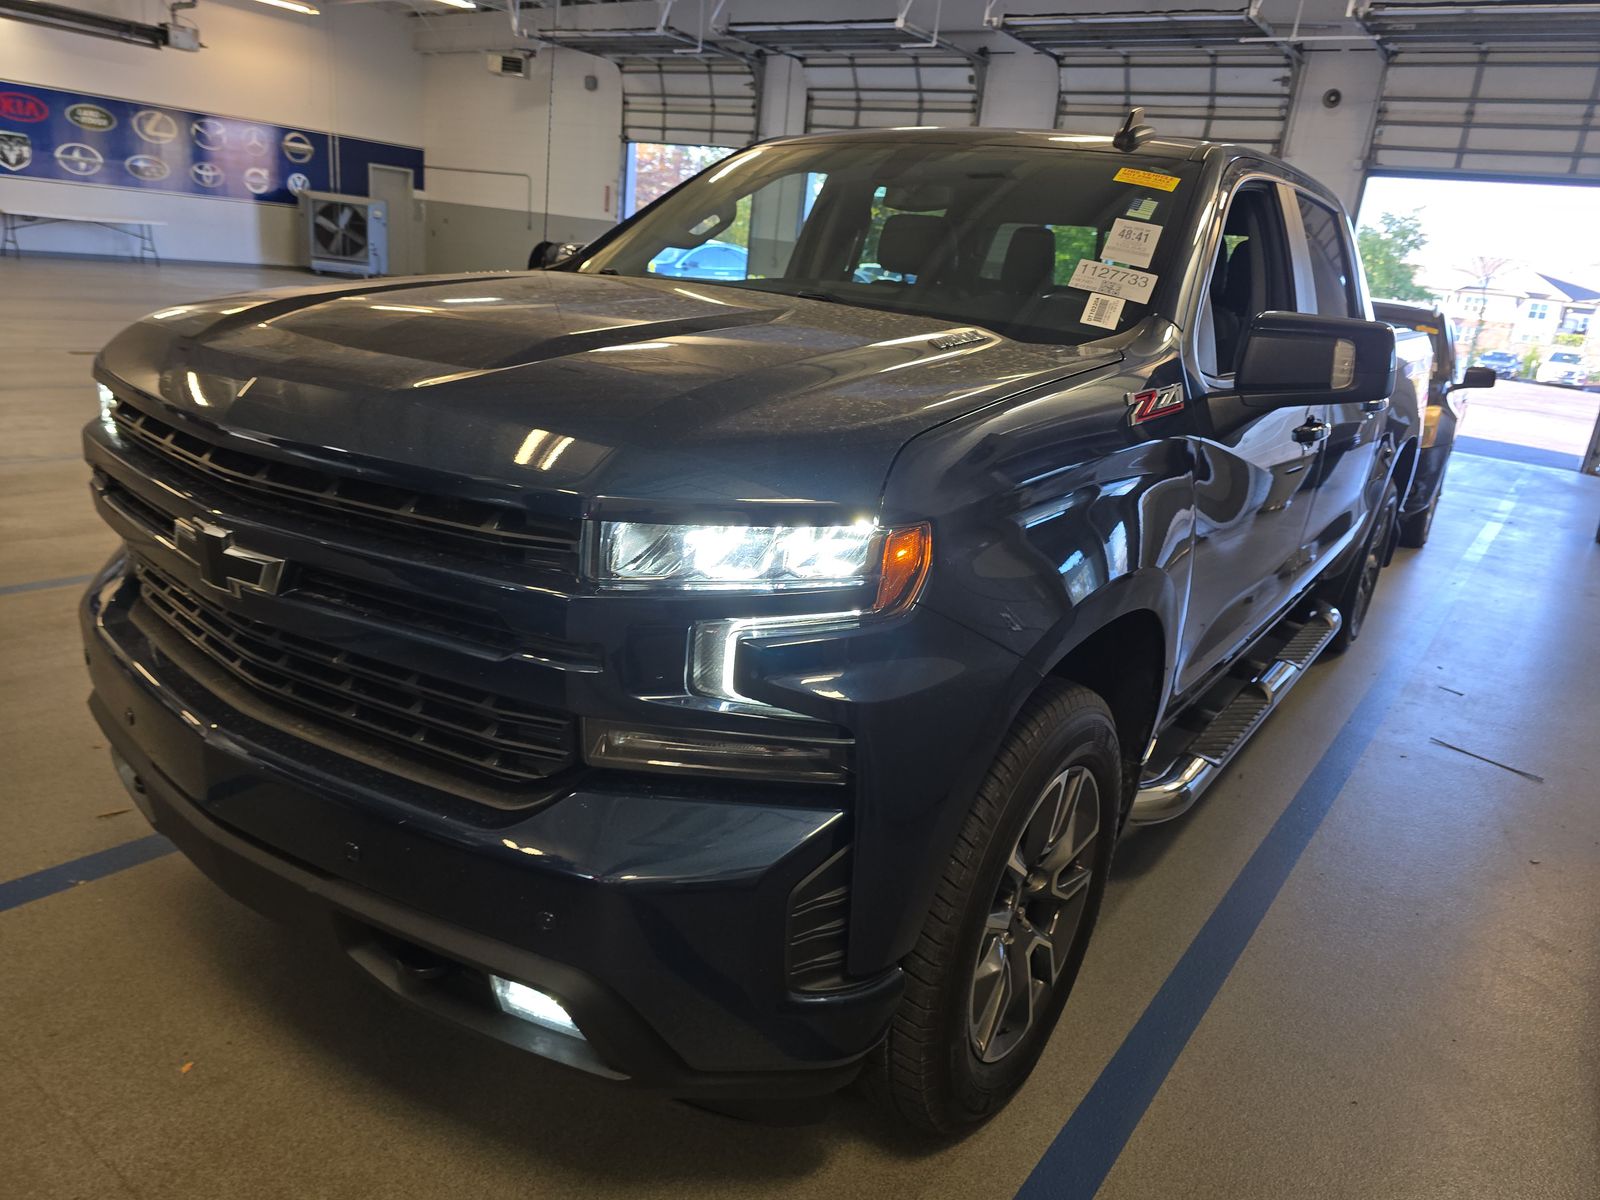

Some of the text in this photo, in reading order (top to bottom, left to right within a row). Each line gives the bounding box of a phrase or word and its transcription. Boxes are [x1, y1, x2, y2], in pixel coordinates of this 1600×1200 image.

[1118, 228, 1150, 243] 48:41
[1081, 264, 1150, 288] 1127733
[1124, 383, 1185, 426] Z71
